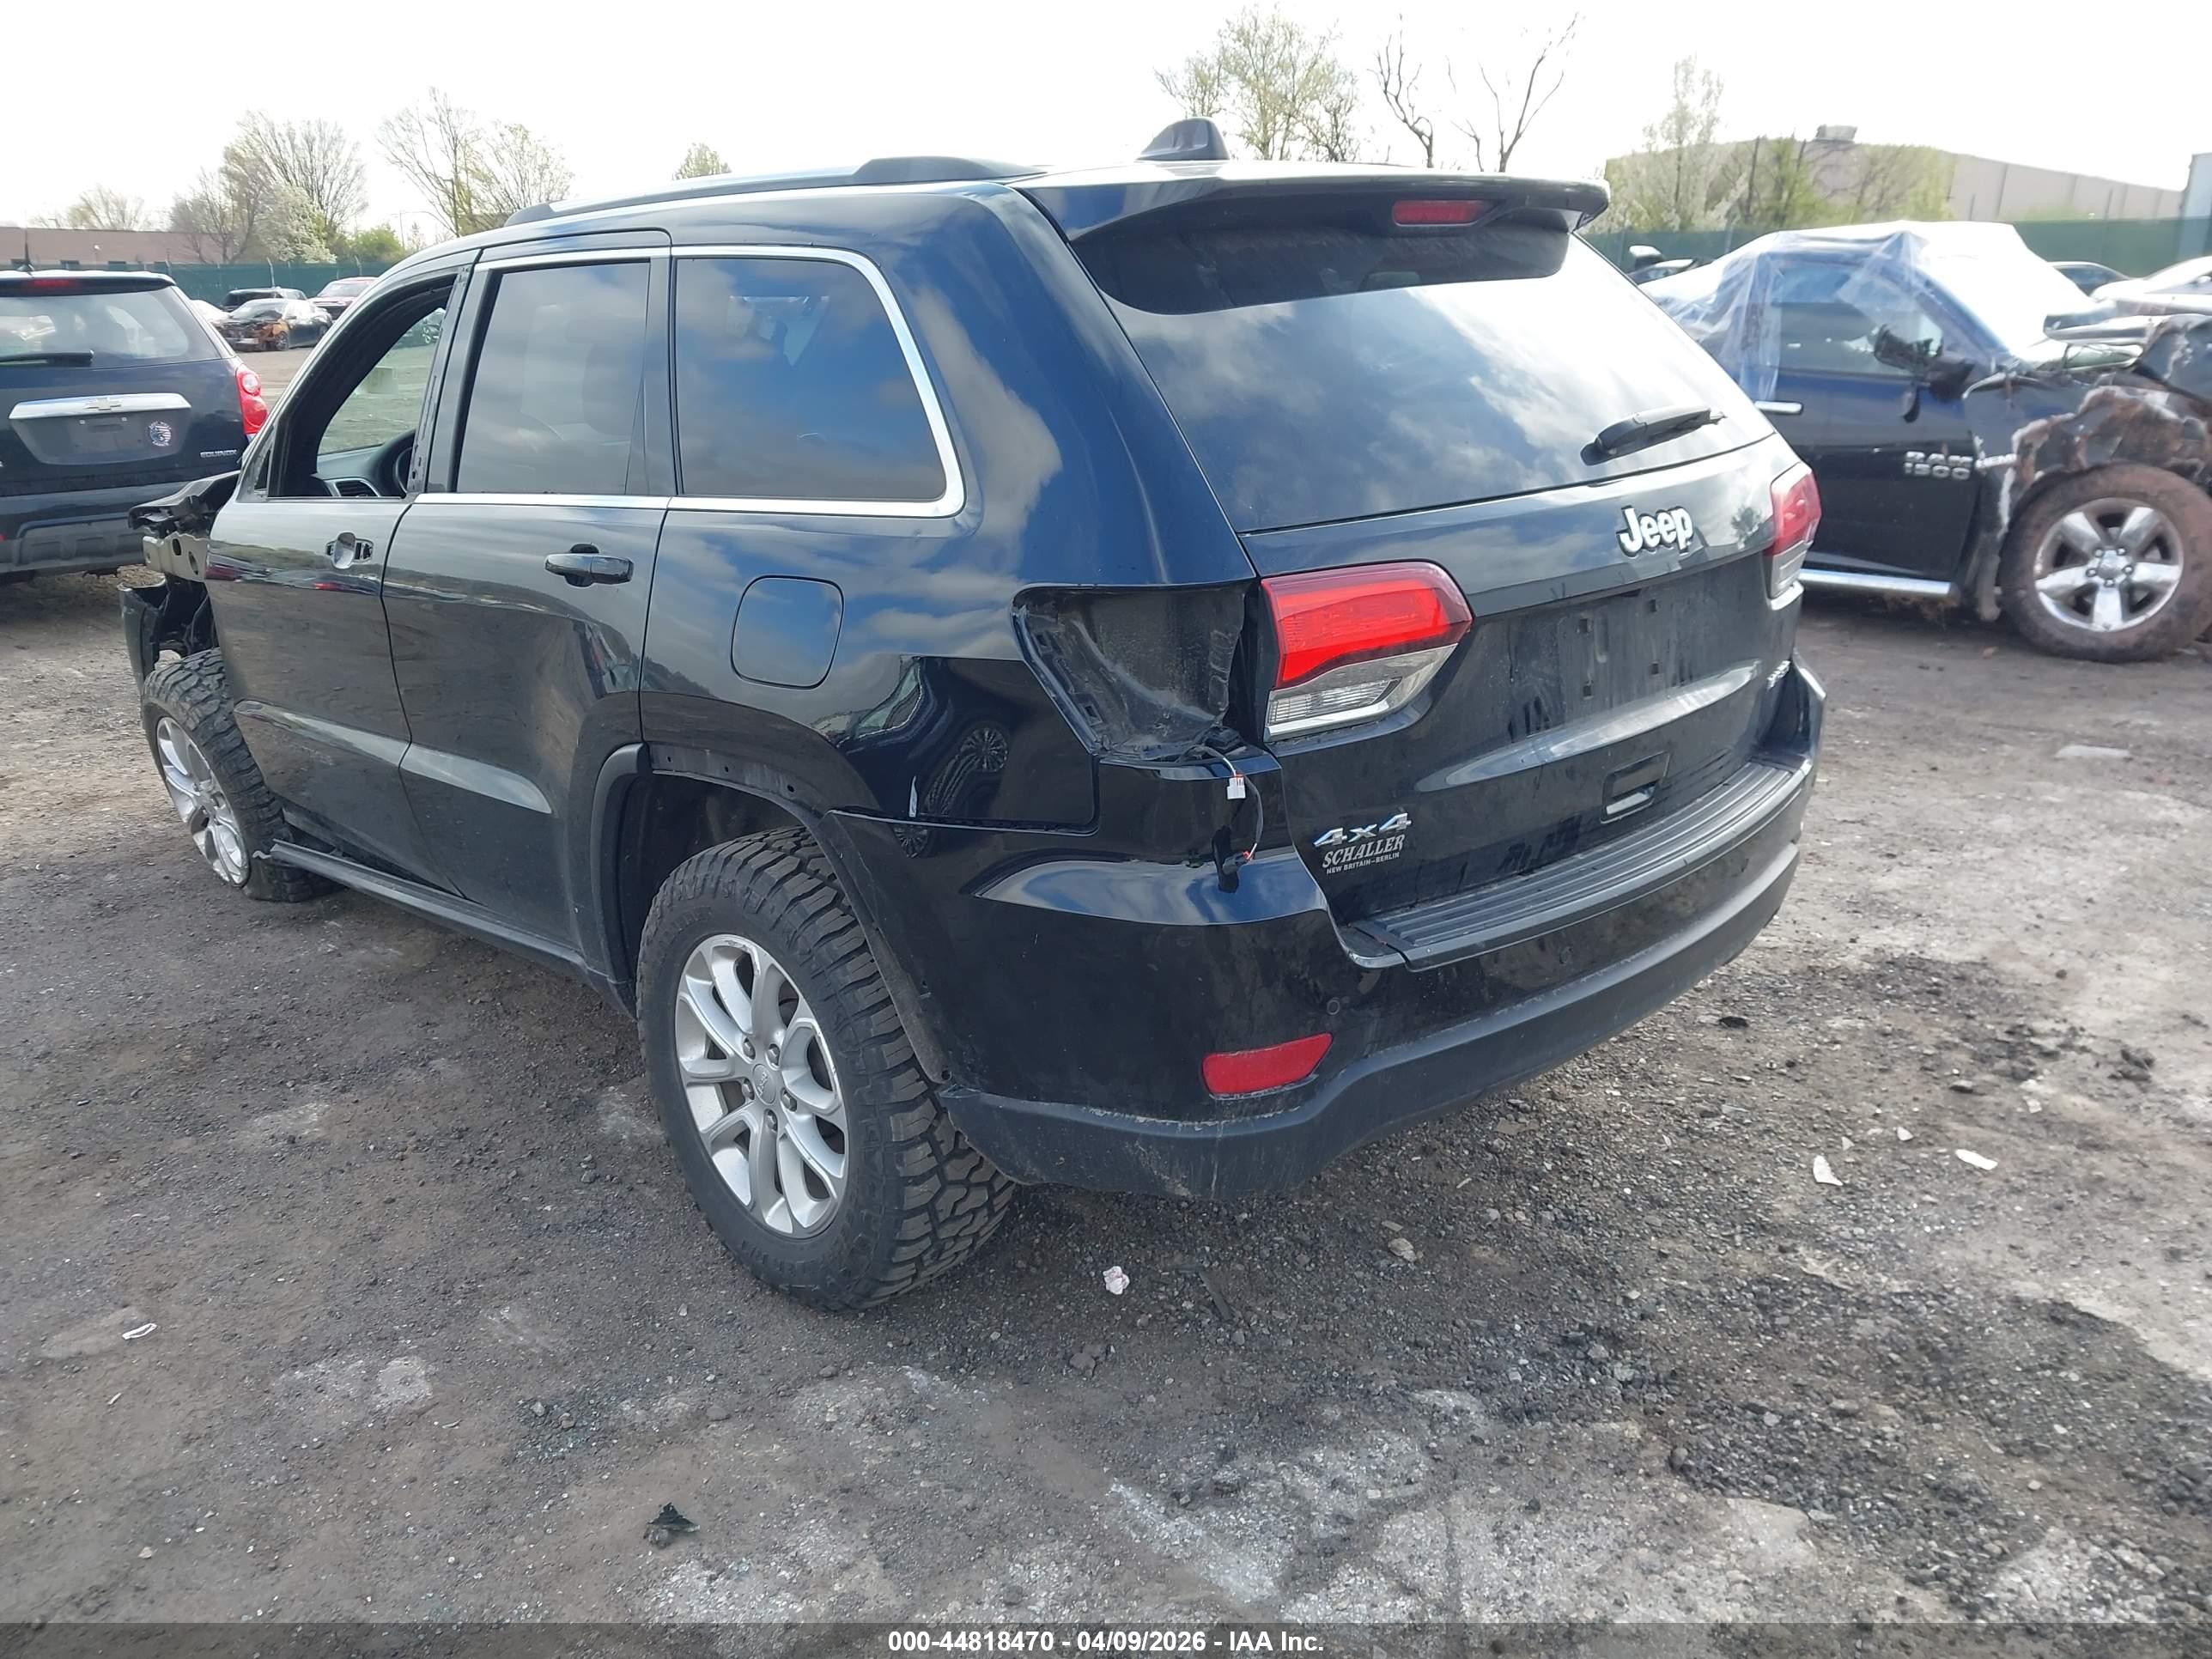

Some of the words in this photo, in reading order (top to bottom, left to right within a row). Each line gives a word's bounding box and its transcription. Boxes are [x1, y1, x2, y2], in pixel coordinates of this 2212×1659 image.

[200, 449, 237, 459] EQUINOX
[1905, 451, 1973, 466] RAM
[1905, 462, 1971, 480] 1500
[1617, 506, 1693, 555] Jeep
[1322, 834, 1405, 868] SCHALLER
[1326, 866, 1342, 874] NEW
